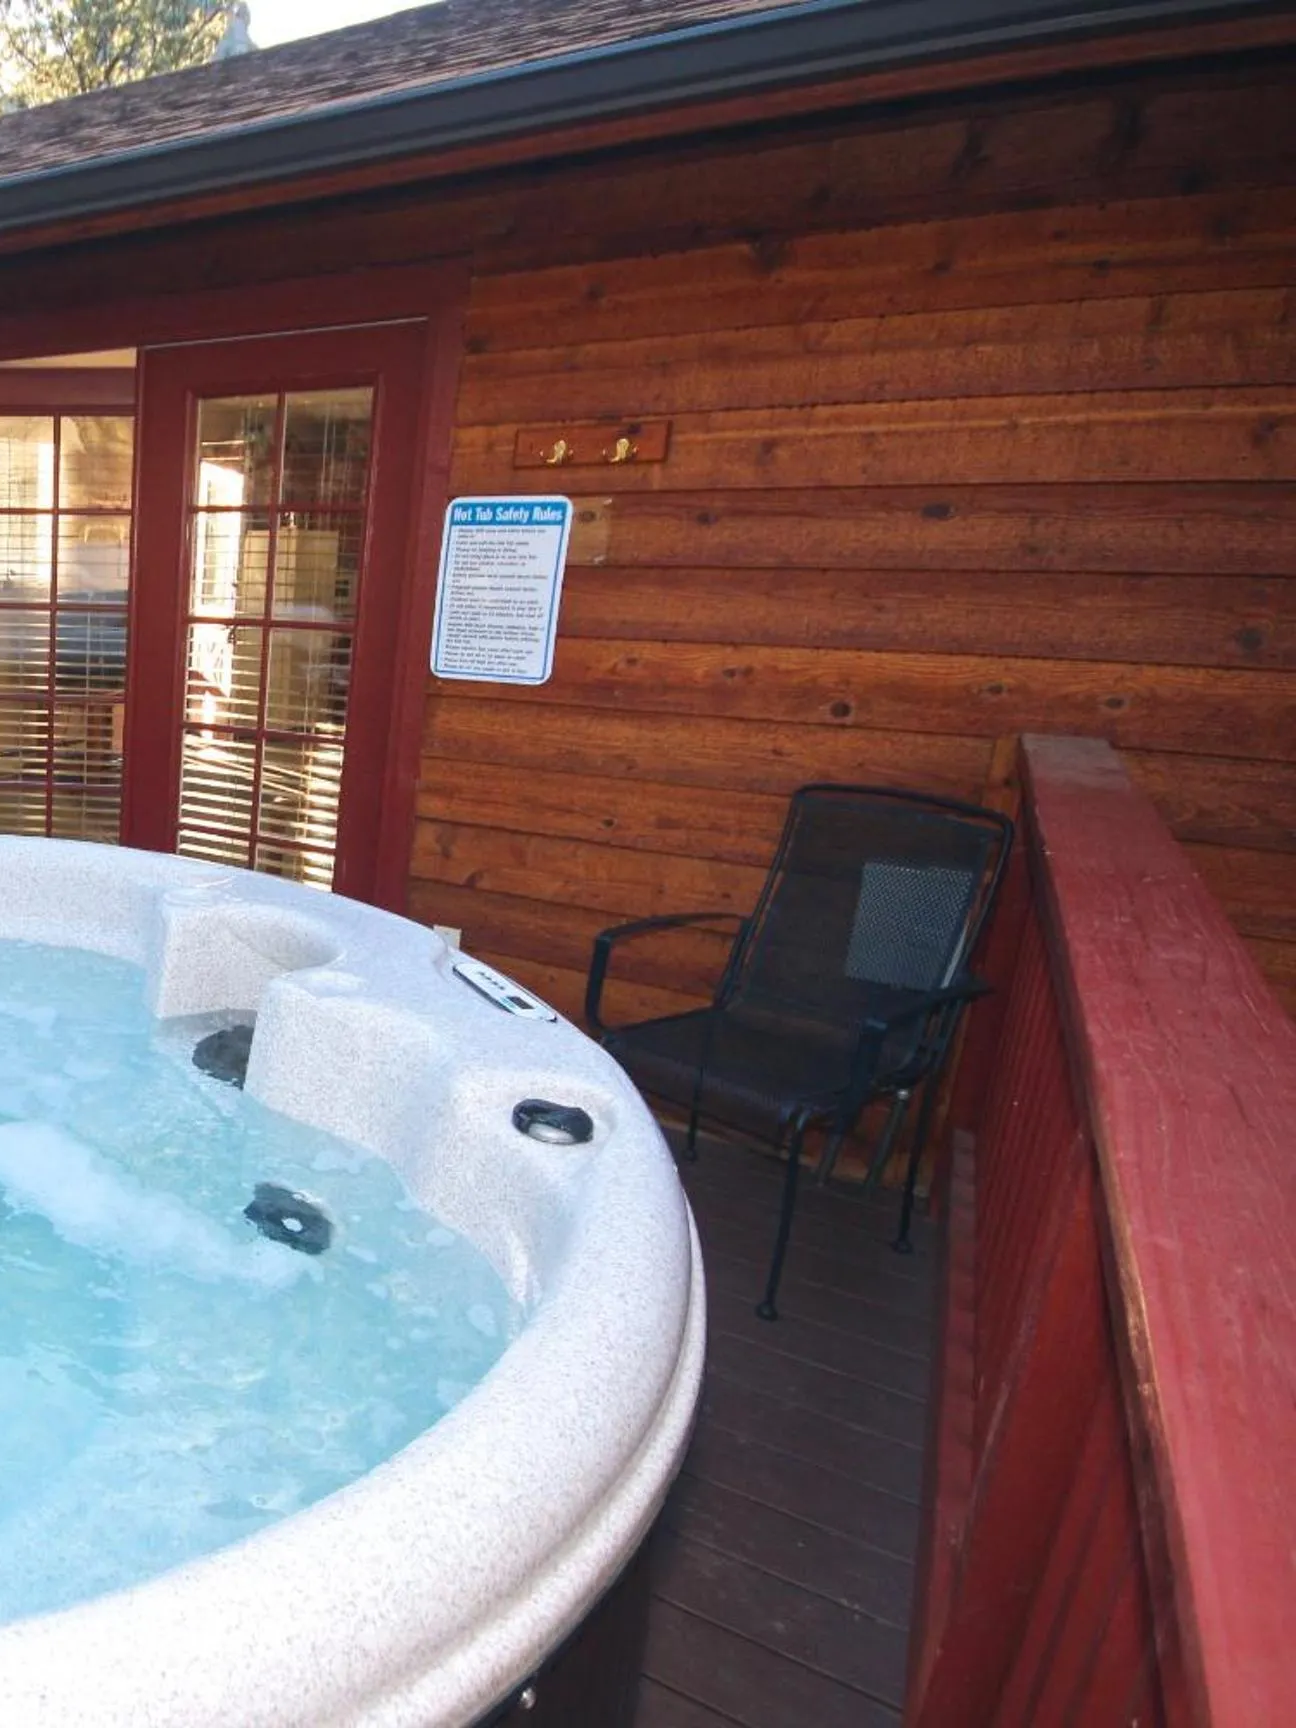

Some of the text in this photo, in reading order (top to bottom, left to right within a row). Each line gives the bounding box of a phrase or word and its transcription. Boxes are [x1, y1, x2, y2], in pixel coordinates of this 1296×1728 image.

[453, 506, 563, 523] Hot Tub Safety Rules
